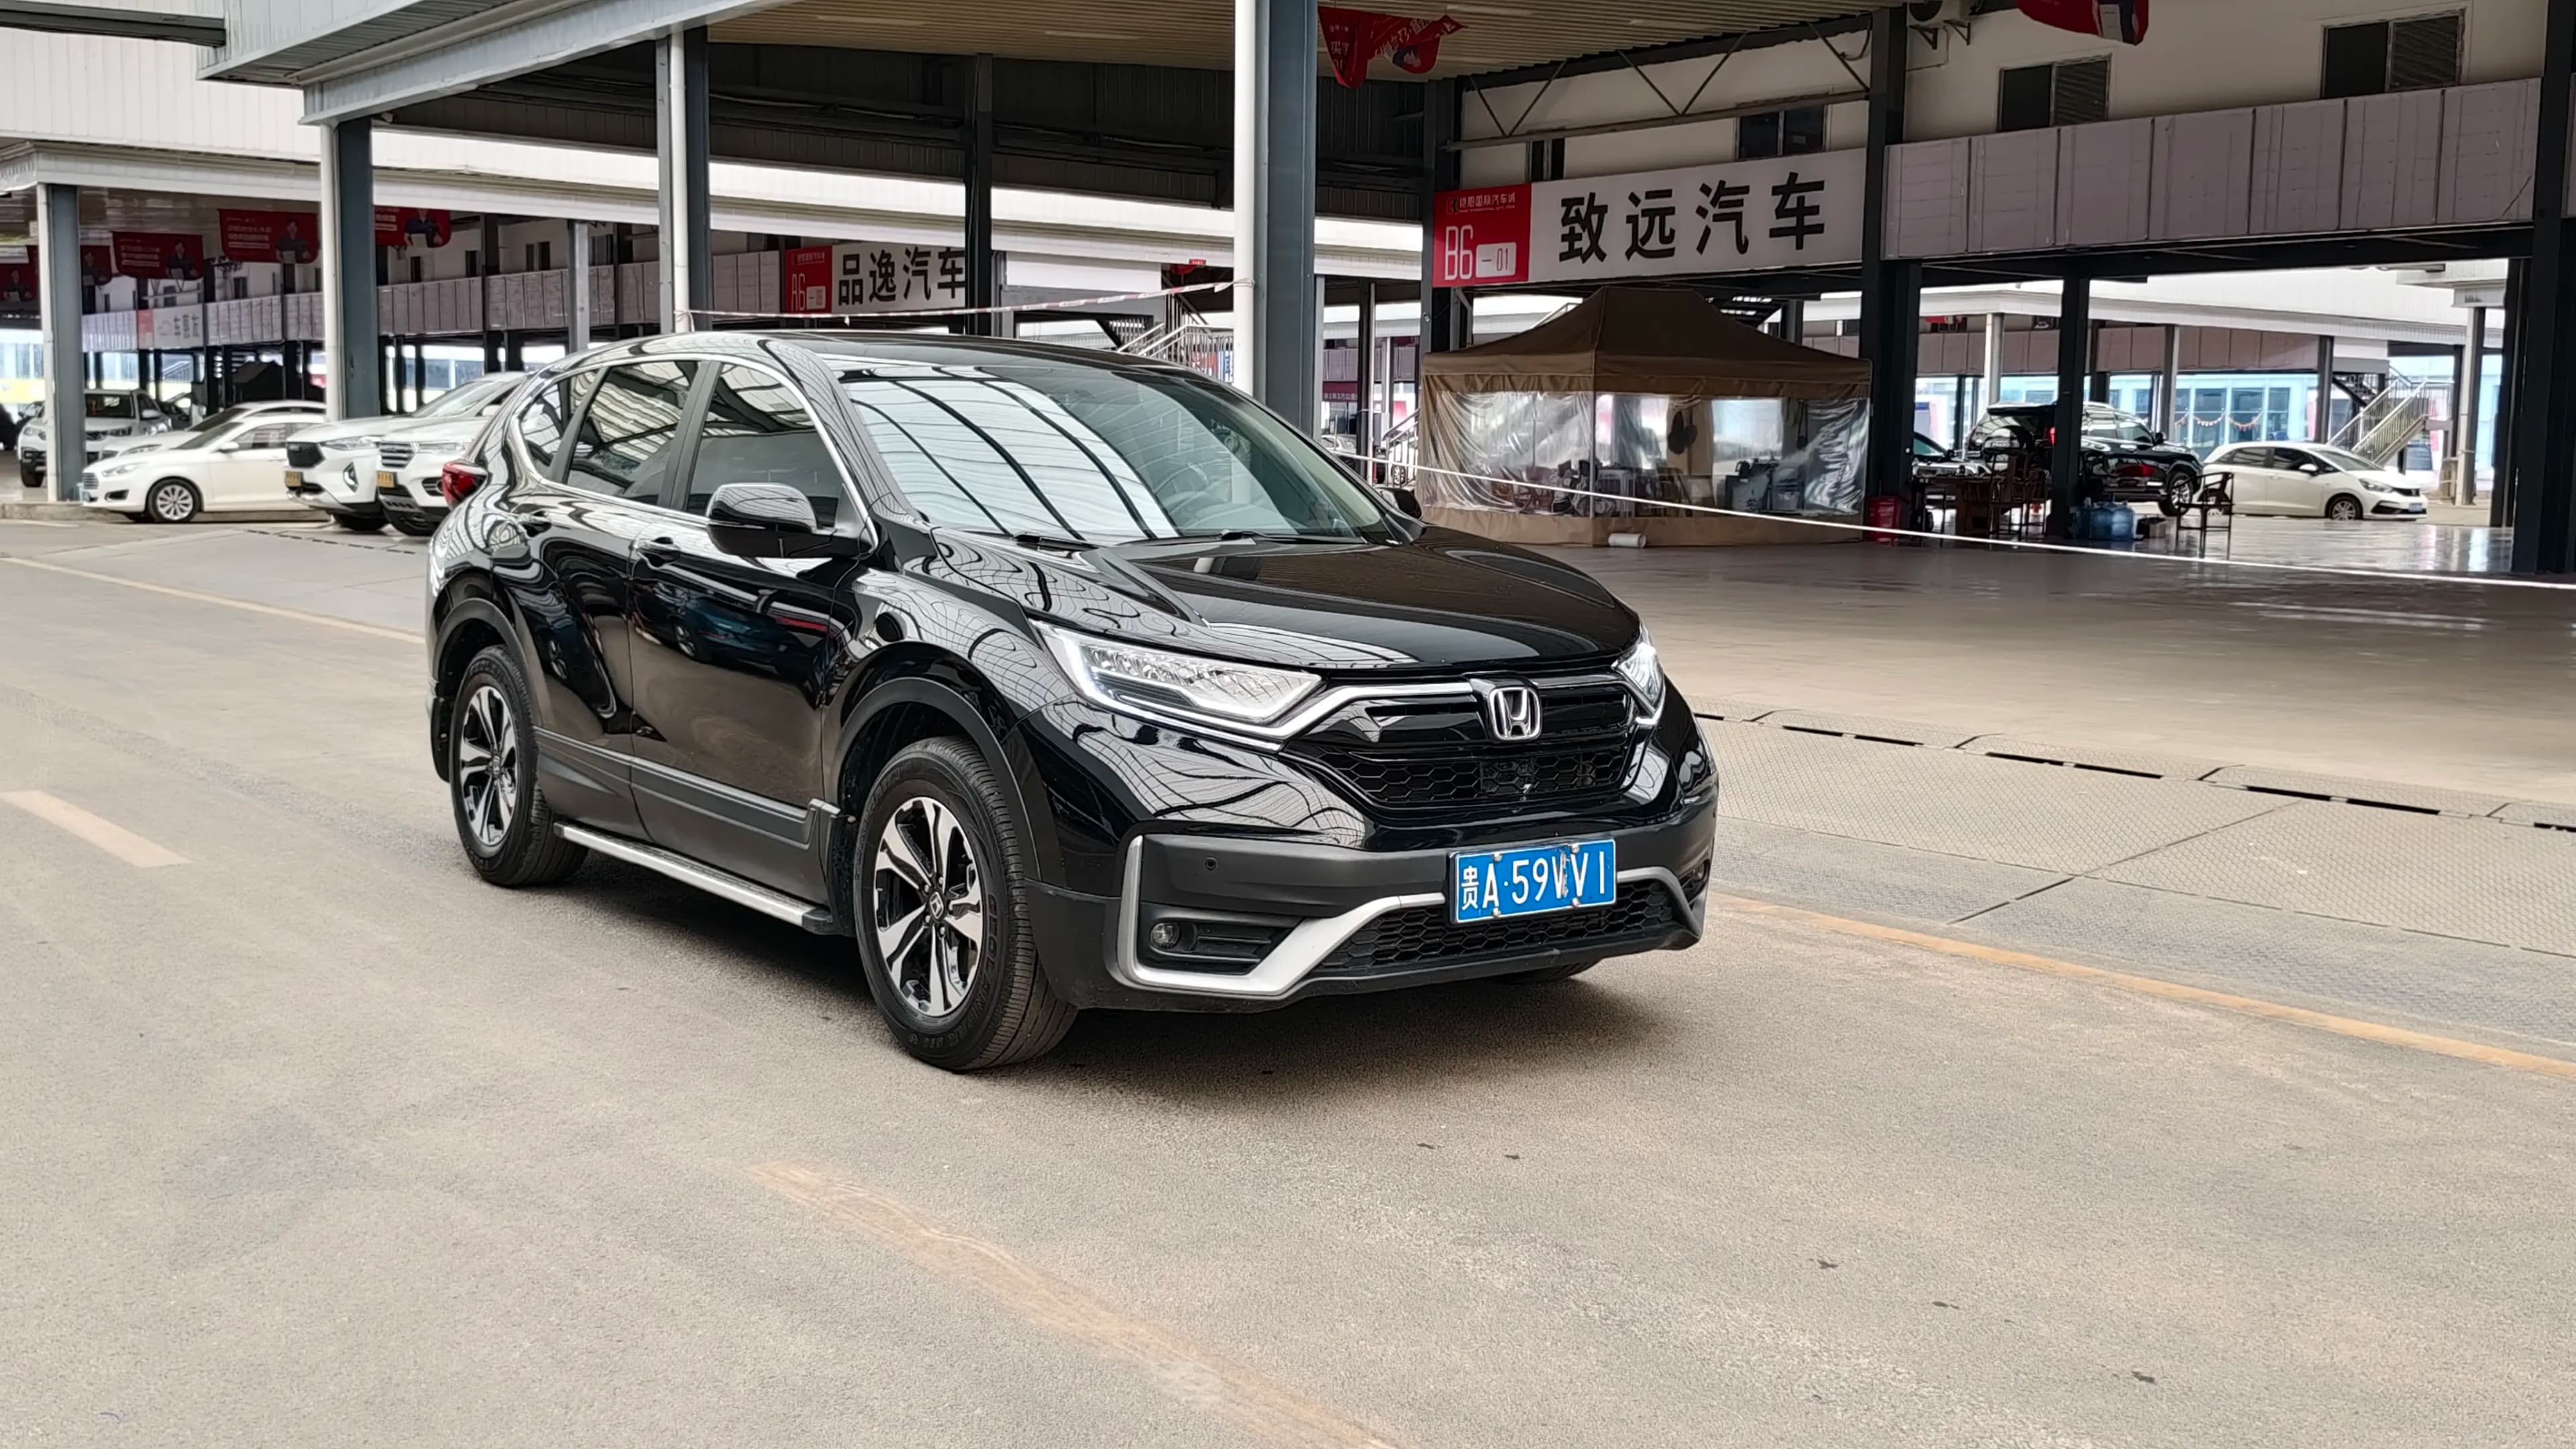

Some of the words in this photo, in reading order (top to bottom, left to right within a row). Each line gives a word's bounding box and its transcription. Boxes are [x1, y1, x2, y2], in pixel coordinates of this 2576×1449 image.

[1558, 171, 1825, 264] 致远汽车
[839, 246, 965, 306] 品逸汽车
[1444, 225, 1474, 280] B6
[791, 272, 806, 312] A6
